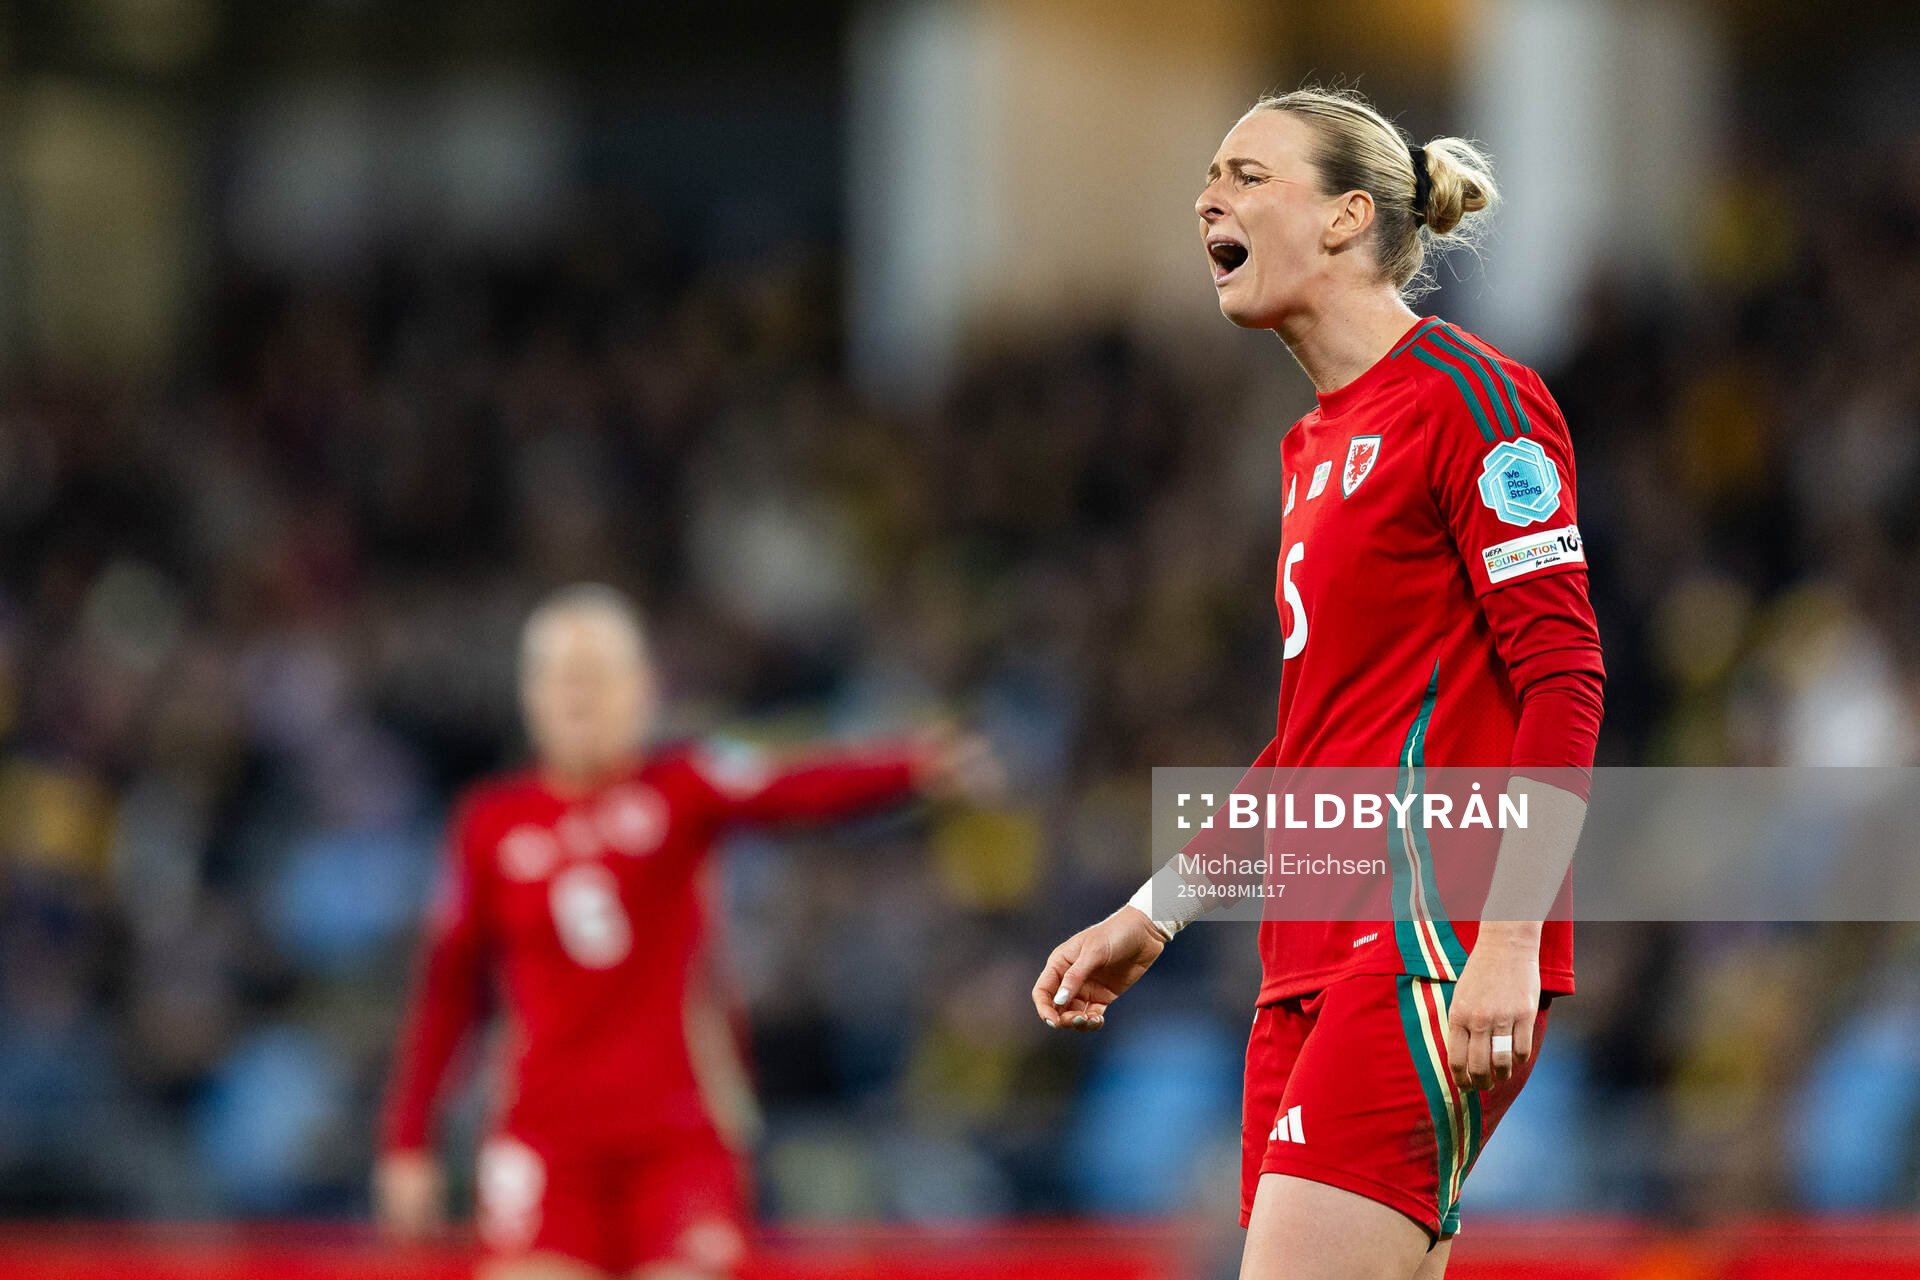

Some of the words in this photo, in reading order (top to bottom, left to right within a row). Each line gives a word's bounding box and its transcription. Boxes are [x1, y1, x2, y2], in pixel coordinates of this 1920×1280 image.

[1504, 470, 1520, 479] We
[1508, 480, 1529, 490] Play
[1510, 486, 1542, 499] Strong
[1485, 547, 1502, 558] UEFA
[1487, 543, 1558, 570] FOUNDATION
[1283, 541, 1308, 660] 5
